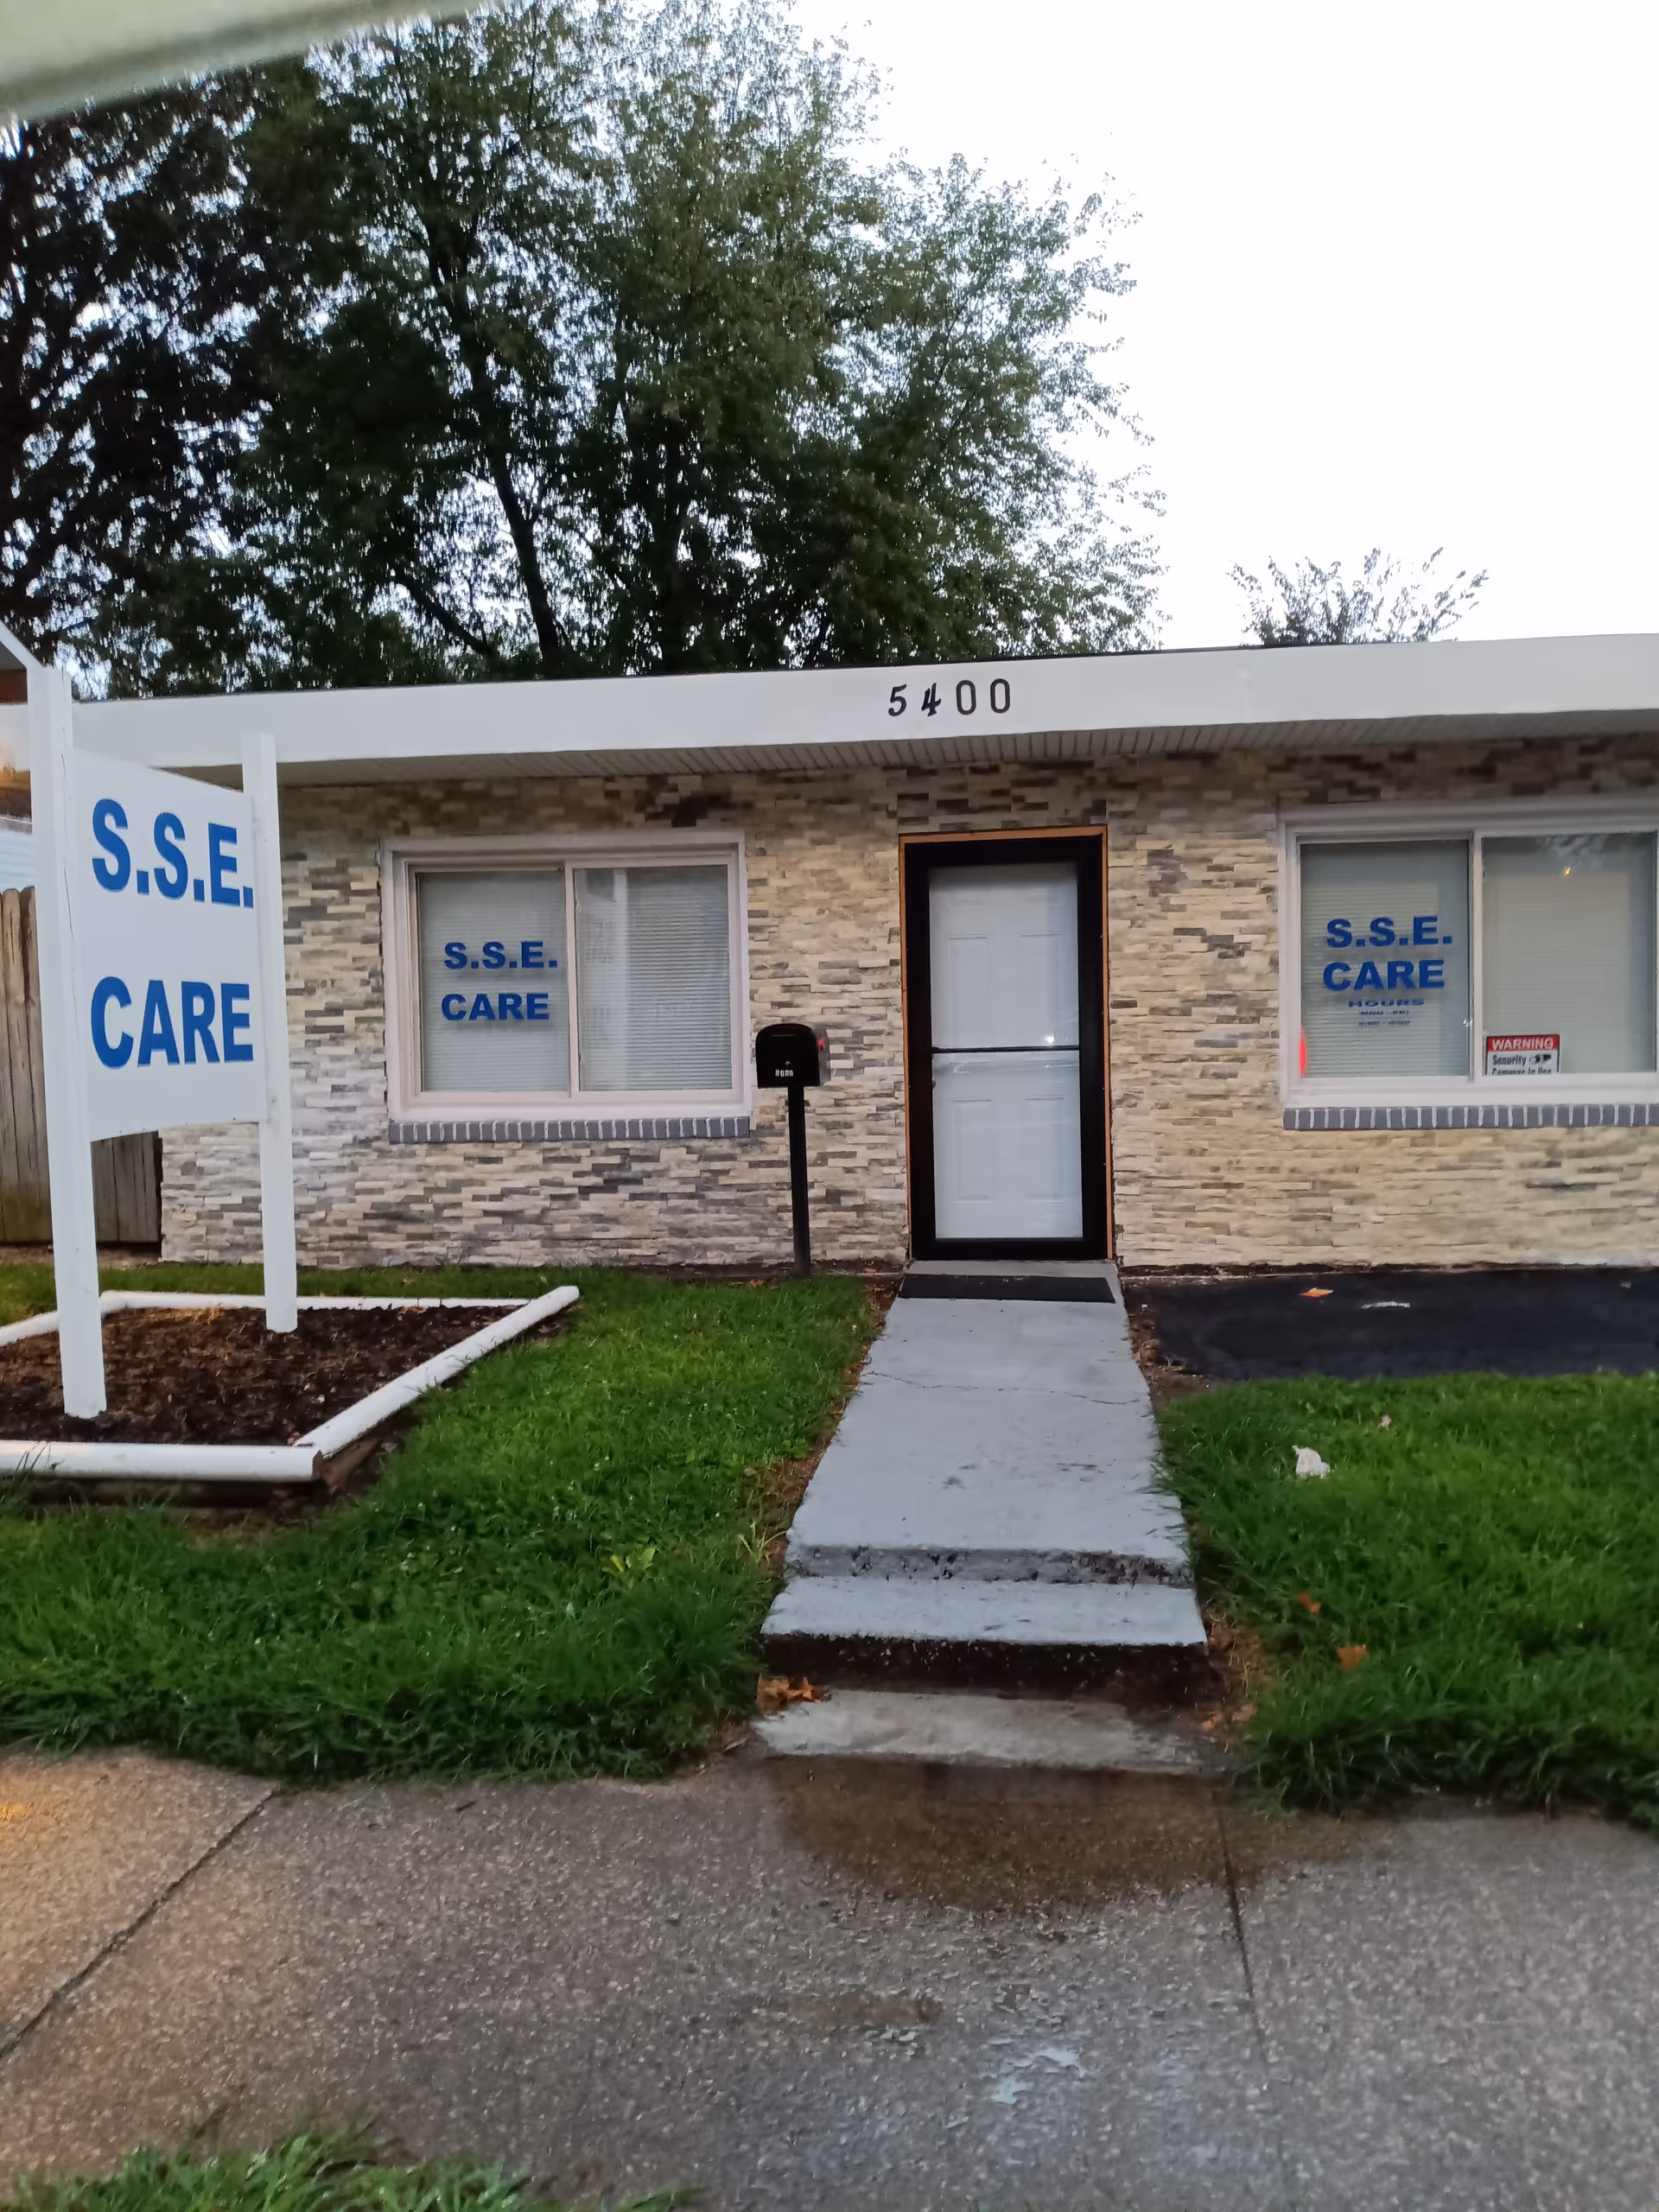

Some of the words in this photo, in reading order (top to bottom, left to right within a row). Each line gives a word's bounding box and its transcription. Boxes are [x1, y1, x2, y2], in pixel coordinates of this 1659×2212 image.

[888, 678, 1010, 716] 5400
[92, 798, 254, 908] S.S.E.
[1326, 916, 1452, 948] S.S.E.
[444, 941, 557, 969] S.S.E.
[1323, 959, 1445, 991] CARE
[91, 976, 254, 1069] CARE
[442, 993, 550, 1020] CARE
[1492, 1038, 1554, 1051] WARNING
[1492, 1055, 1527, 1066] Security
